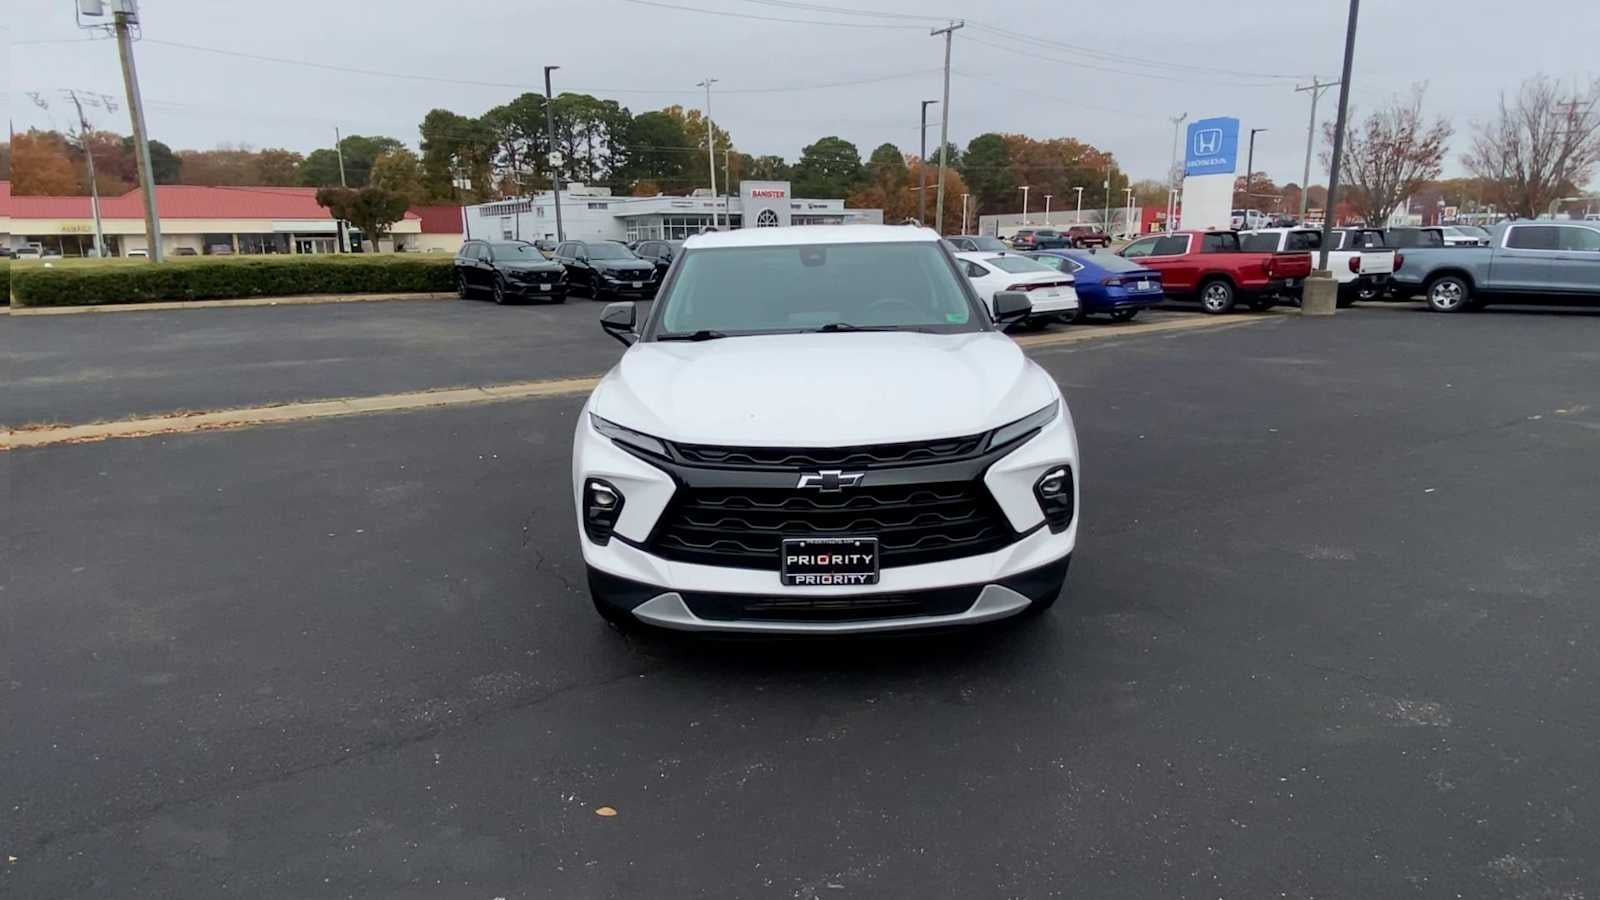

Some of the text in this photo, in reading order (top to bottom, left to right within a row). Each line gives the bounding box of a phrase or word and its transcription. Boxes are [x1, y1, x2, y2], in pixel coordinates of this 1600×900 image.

[1187, 158, 1227, 168] HONDA
[752, 189, 785, 199] BANISTER
[787, 554, 873, 566] PRIORITY
[795, 575, 867, 585] PRIORITY
